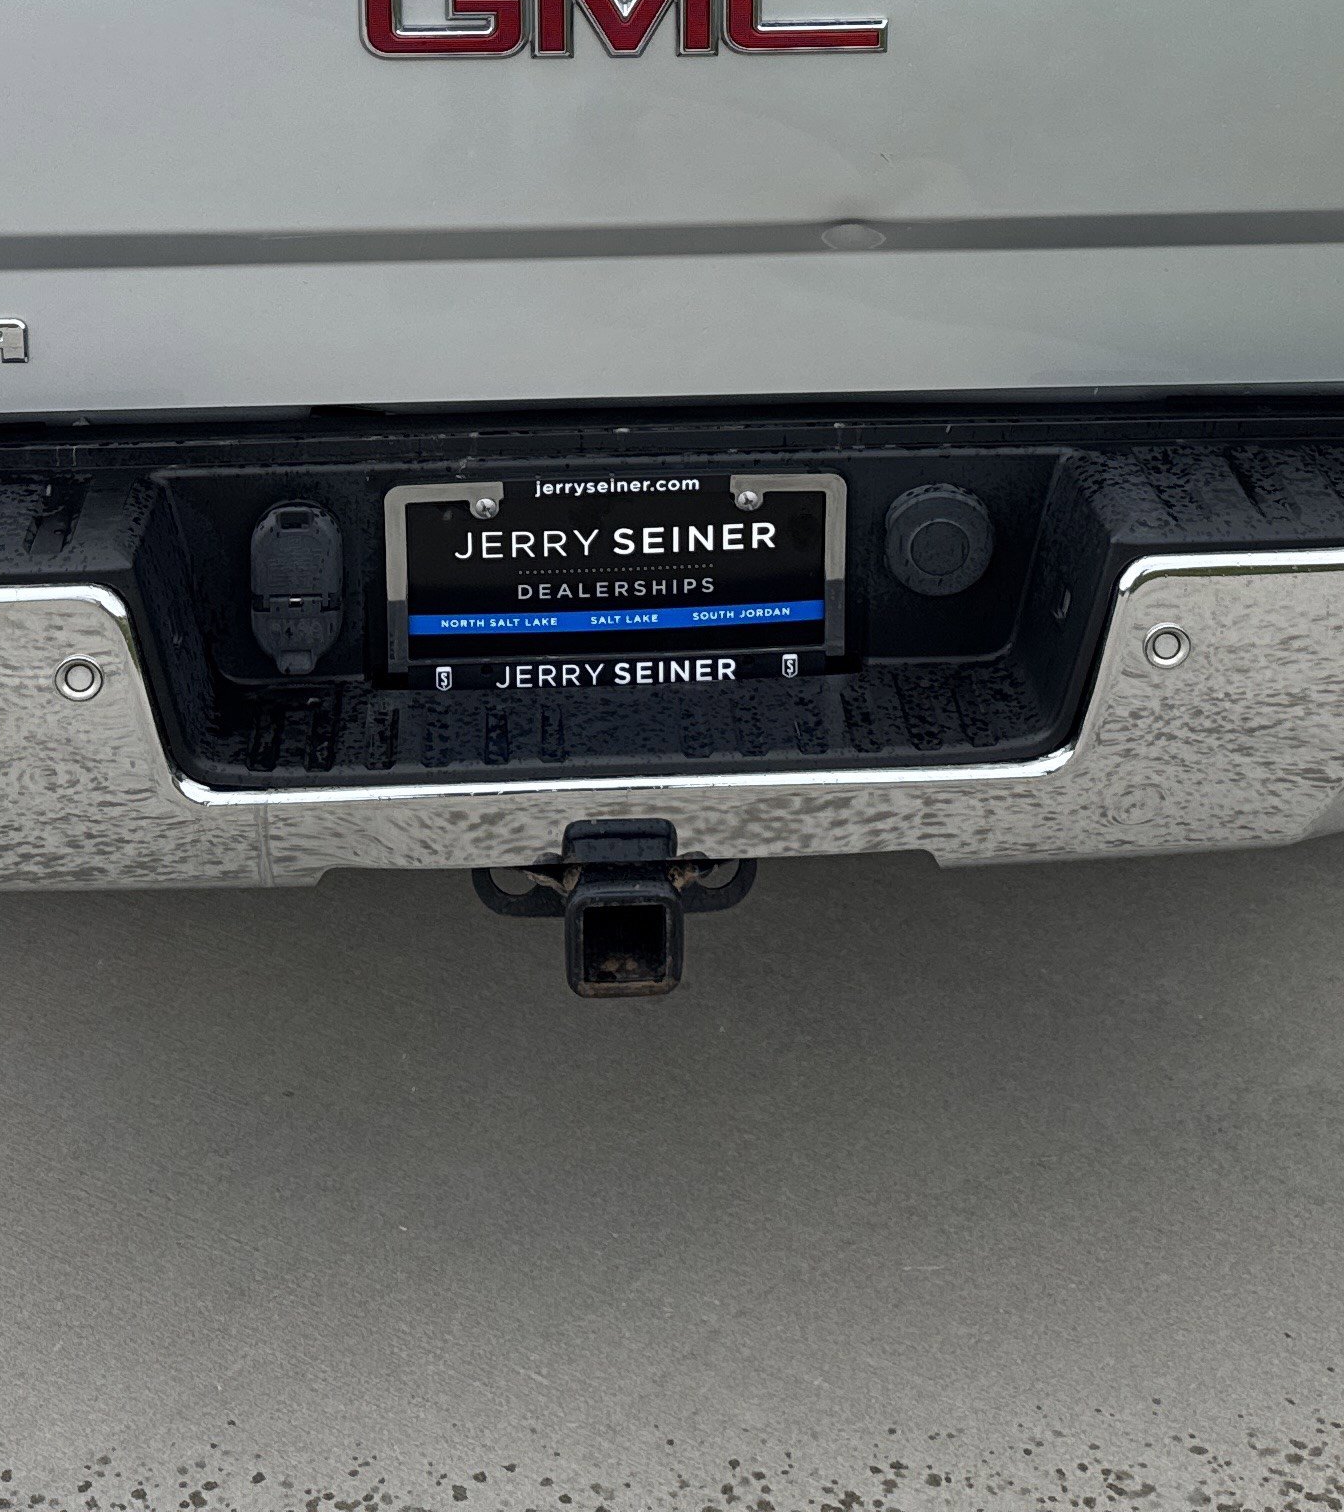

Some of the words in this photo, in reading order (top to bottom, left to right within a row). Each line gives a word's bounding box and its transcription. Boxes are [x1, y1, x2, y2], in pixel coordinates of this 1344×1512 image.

[535, 477, 700, 498] jerryseiner.com
[454, 529, 599, 559] JERRY
[613, 522, 776, 556] SEINER
[518, 577, 715, 600] DEALERSHIPS
[441, 619, 485, 628] NORTH
[489, 618, 521, 627] SALT
[525, 617, 558, 626] LAKE
[590, 616, 621, 625] SALT
[626, 614, 659, 624] LAKE
[692, 610, 735, 621] SOUTH
[739, 607, 791, 618] JORDAN
[496, 664, 605, 689] JERRY
[614, 658, 737, 685] SEINER
